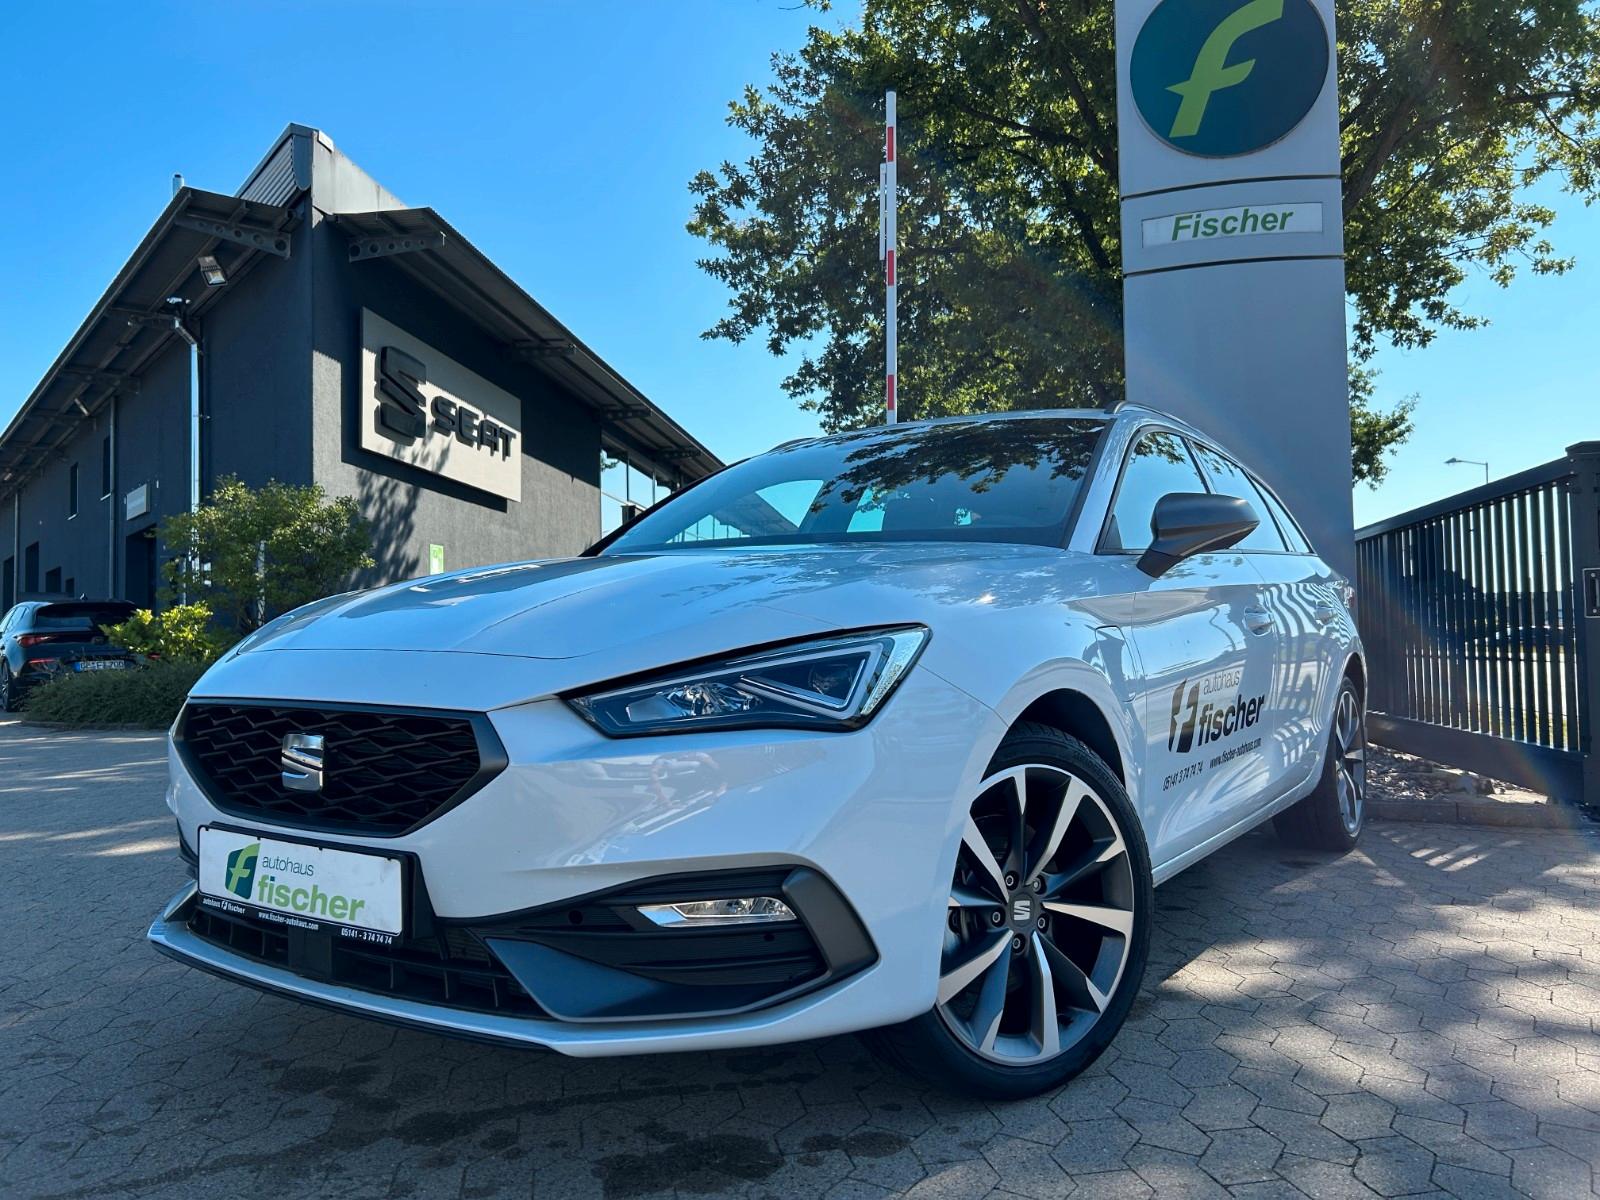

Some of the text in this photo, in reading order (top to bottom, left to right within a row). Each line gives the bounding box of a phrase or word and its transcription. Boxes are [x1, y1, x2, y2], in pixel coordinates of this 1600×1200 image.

[1171, 208, 1294, 241] Fischer
[432, 395, 517, 460] SEAT
[1203, 670, 1240, 695] autohaus
[1198, 693, 1265, 746] fischer
[262, 855, 314, 877] autohaus
[228, 903, 246, 914] fischer
[257, 874, 365, 921] fischer
[341, 927, 358, 938] 05141
[368, 932, 376, 942] 74
[376, 934, 384, 943] 74
[384, 935, 393, 944] 74
